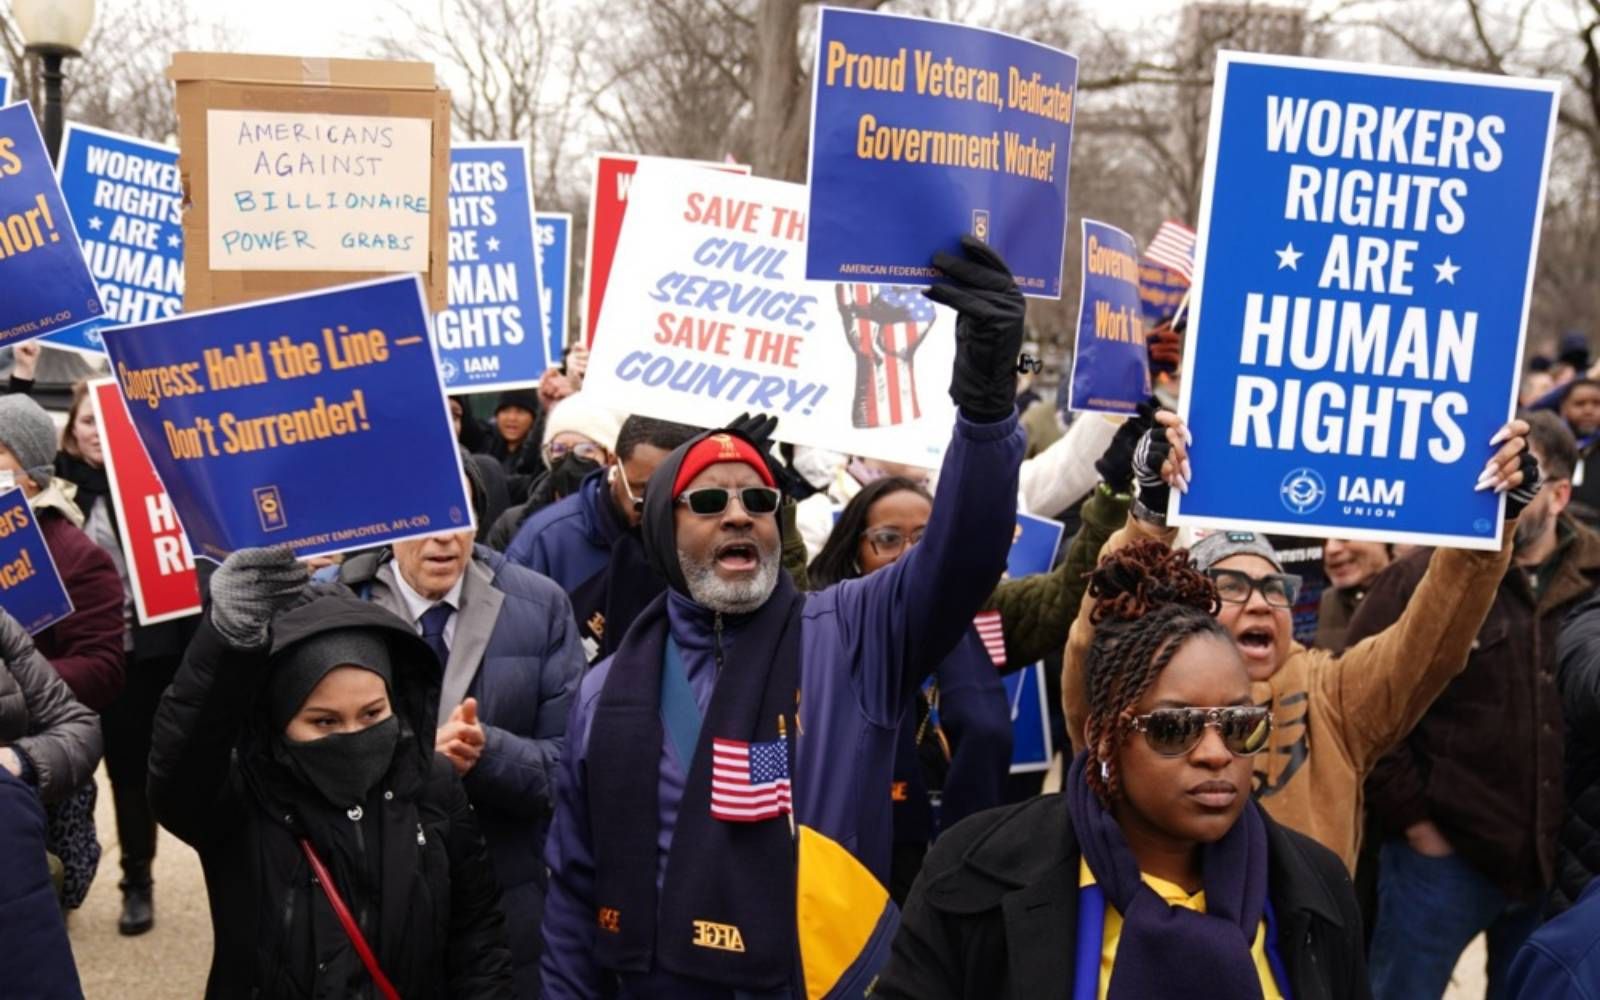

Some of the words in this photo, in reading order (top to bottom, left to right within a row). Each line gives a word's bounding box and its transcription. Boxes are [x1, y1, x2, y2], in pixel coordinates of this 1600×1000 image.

[826, 40, 907, 93] Proud
[914, 49, 1004, 112] Veteran,
[1008, 66, 1073, 124] Dedicated
[238, 121, 393, 148] AMERICANS
[857, 114, 1000, 171] Government
[1004, 130, 1056, 183] Worker!
[1266, 95, 1505, 172] WORKERS
[254, 151, 383, 177] AGAINST
[449, 161, 508, 193] KERS
[94, 180, 183, 225] RIGHTS
[234, 191, 430, 214] BILLIONAIRE
[449, 196, 497, 227] HTS
[684, 192, 763, 234] SAVE
[770, 206, 806, 242] TH
[1284, 164, 1468, 235] RIGHTS
[0, 193, 60, 259] nor!
[109, 215, 162, 250] ARE
[222, 230, 317, 255] POWER
[341, 233, 414, 251] GRABS
[448, 230, 480, 261] RE
[693, 237, 788, 280] CIVIL
[839, 263, 887, 276] AMERICAN
[1318, 234, 1419, 295] ARE
[99, 283, 182, 323] GHTS
[448, 262, 519, 305] MAN
[648, 271, 818, 331] SERVICE,
[437, 306, 525, 351] GHTS
[654, 312, 735, 356] SAVE
[743, 327, 804, 369] THE
[1096, 300, 1129, 343] Work
[1239, 292, 1478, 383] HUMAN
[118, 361, 205, 409] Congress:
[203, 341, 268, 391] Hold
[269, 336, 322, 379] the
[322, 325, 389, 370] Line
[464, 356, 500, 373] IAM
[615, 350, 829, 416] COUNTRY!
[163, 416, 220, 460] Don't
[218, 389, 370, 454] Surrender!
[1230, 375, 1469, 464] RIGHTS
[1338, 476, 1405, 506] IAM
[1343, 506, 1397, 518] UNION
[332, 523, 391, 542] EMPLOYEES,
[392, 515, 430, 530] AFL-CIO
